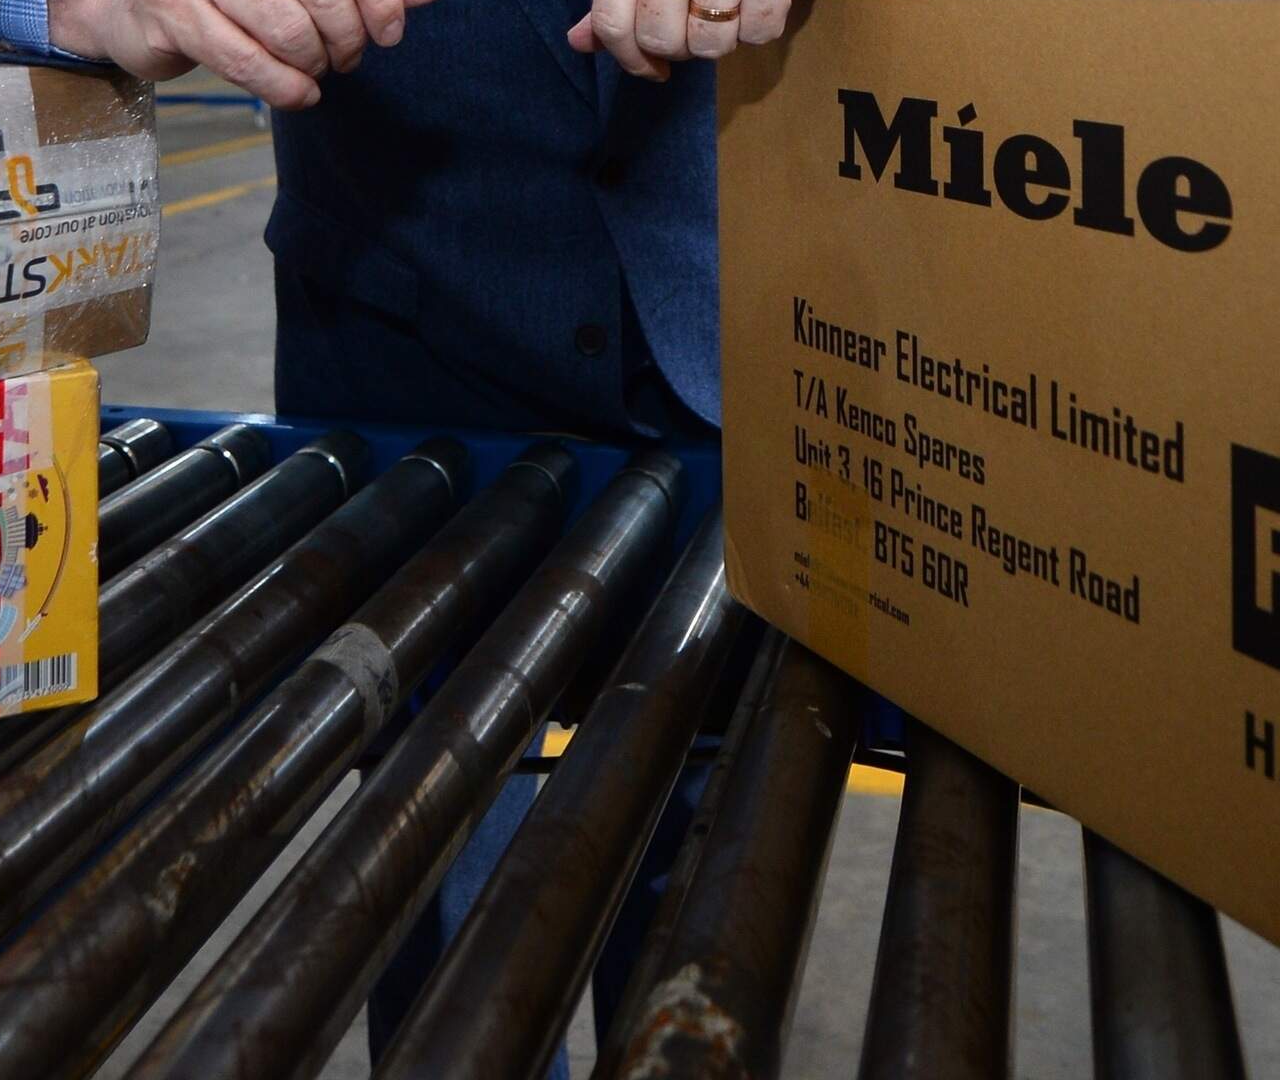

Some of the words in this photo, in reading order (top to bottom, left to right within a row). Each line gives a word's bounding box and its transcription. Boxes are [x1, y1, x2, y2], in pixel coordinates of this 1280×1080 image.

[837, 88, 1233, 253] Miele
[19, 225, 52, 245] core
[54, 221, 79, 237] our
[81, 217, 97, 234] at
[793, 296, 886, 372] Kinnear
[896, 329, 1038, 429] Electrical
[1050, 380, 1185, 483] Limited
[793, 369, 828, 418] T/A
[836, 387, 896, 447] Kenco
[904, 413, 985, 486] Spares
[795, 425, 832, 470] Unit
[863, 455, 883, 502] 16
[890, 468, 963, 541] Prince
[971, 503, 1060, 587] Regent
[1069, 546, 1140, 625] Road
[874, 520, 914, 578] BT5
[922, 544, 969, 608] 6QR
